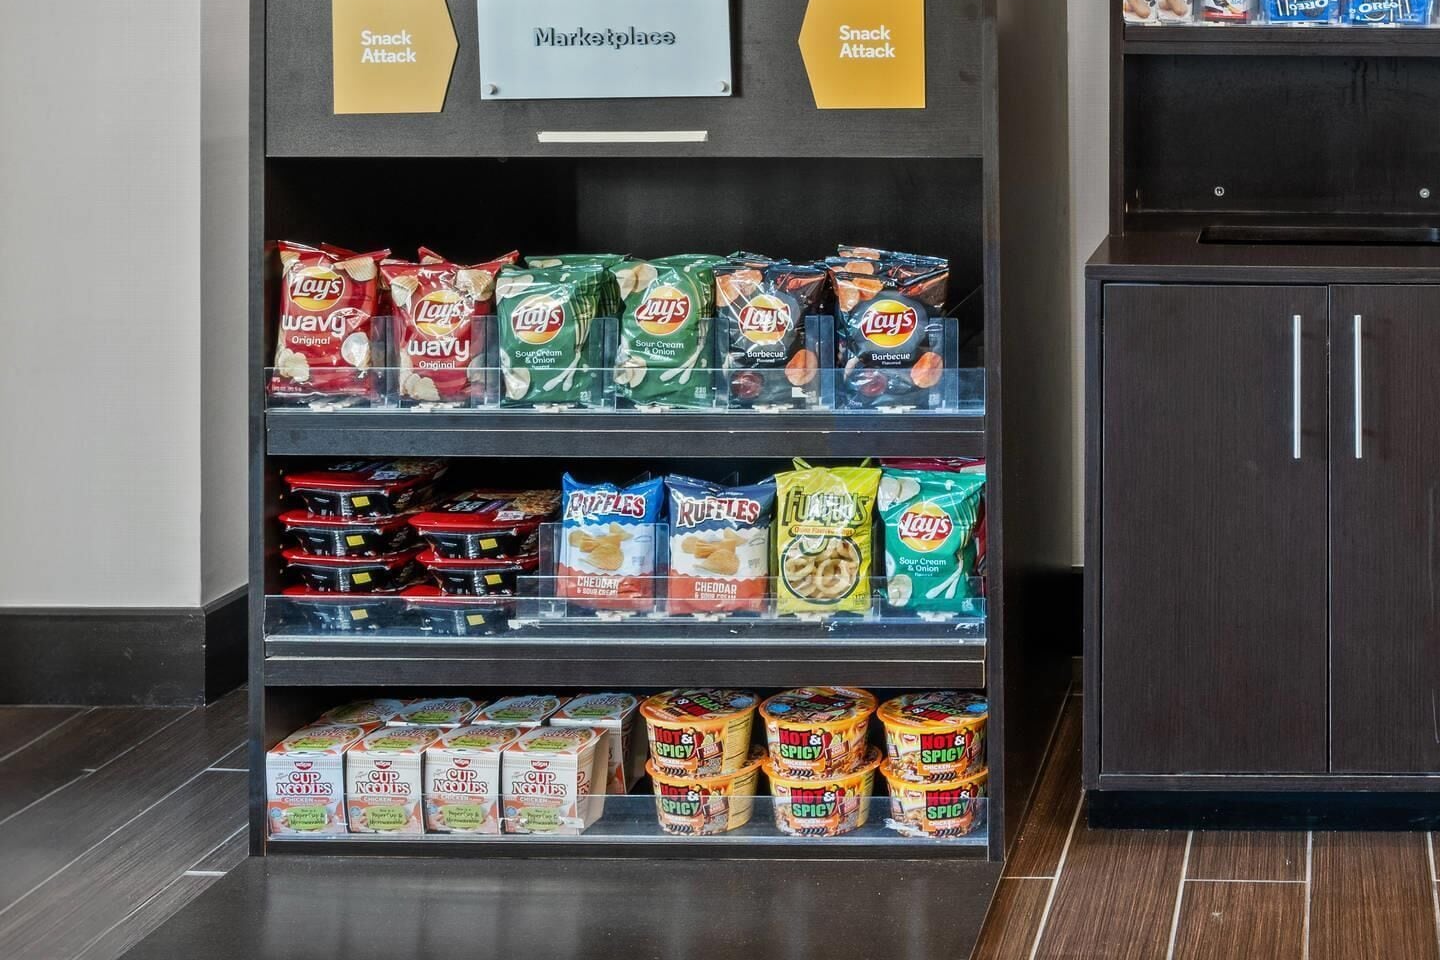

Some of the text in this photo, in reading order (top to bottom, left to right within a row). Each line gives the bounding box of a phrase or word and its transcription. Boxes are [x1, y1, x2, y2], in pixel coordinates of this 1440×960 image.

[1358, 1, 1398, 13] OREO
[361, 30, 412, 45] Snack
[533, 26, 676, 49] Marketplace
[839, 24, 891, 40] Snack
[361, 47, 416, 63] Attack
[839, 42, 896, 58] Attack
[293, 275, 342, 302] Lay's
[416, 302, 468, 328] Lay's
[512, 304, 564, 332] Lay's
[638, 297, 690, 327] Lay's
[282, 314, 346, 342] wavy
[861, 307, 914, 336] Lay's
[291, 335, 331, 346] Original
[635, 339, 684, 349] Sour Cream
[407, 338, 470, 361] wavy
[515, 349, 536, 358] Sour
[643, 347, 676, 356] & Onion
[746, 349, 784, 359] Barbecue
[871, 352, 911, 362] Barbecue
[419, 359, 456, 370] Original
[532, 355, 557, 364] Onion
[566, 491, 646, 519] RUFFLES
[676, 497, 760, 527] RUFFLES
[903, 514, 949, 540] Lay's
[899, 556, 946, 566] Sour Cream
[907, 564, 939, 572] & Onion
[577, 576, 619, 590] CHEDDAR
[695, 581, 737, 594] CHEDDAR
[654, 725, 694, 744] HOT &
[779, 727, 822, 746] HOT &
[921, 732, 965, 749] HOT &
[657, 743, 695, 759] SPICY
[781, 744, 820, 760] SPICY
[922, 747, 964, 763] SPICY
[287, 771, 321, 784] CUP
[368, 769, 400, 784] CUP
[446, 768, 477, 782] CUP
[524, 770, 556, 784] CUP
[276, 782, 333, 796] NOODLES
[355, 781, 411, 796] NOODLES
[433, 779, 488, 794] NOODLES
[512, 782, 567, 797] NOODLES
[661, 783, 700, 801] HOT &
[791, 787, 836, 804] HOT &
[927, 790, 970, 806] HOT &
[662, 798, 700, 817] SPICY
[792, 802, 834, 818] SPICY
[928, 801, 968, 819] SPICY
